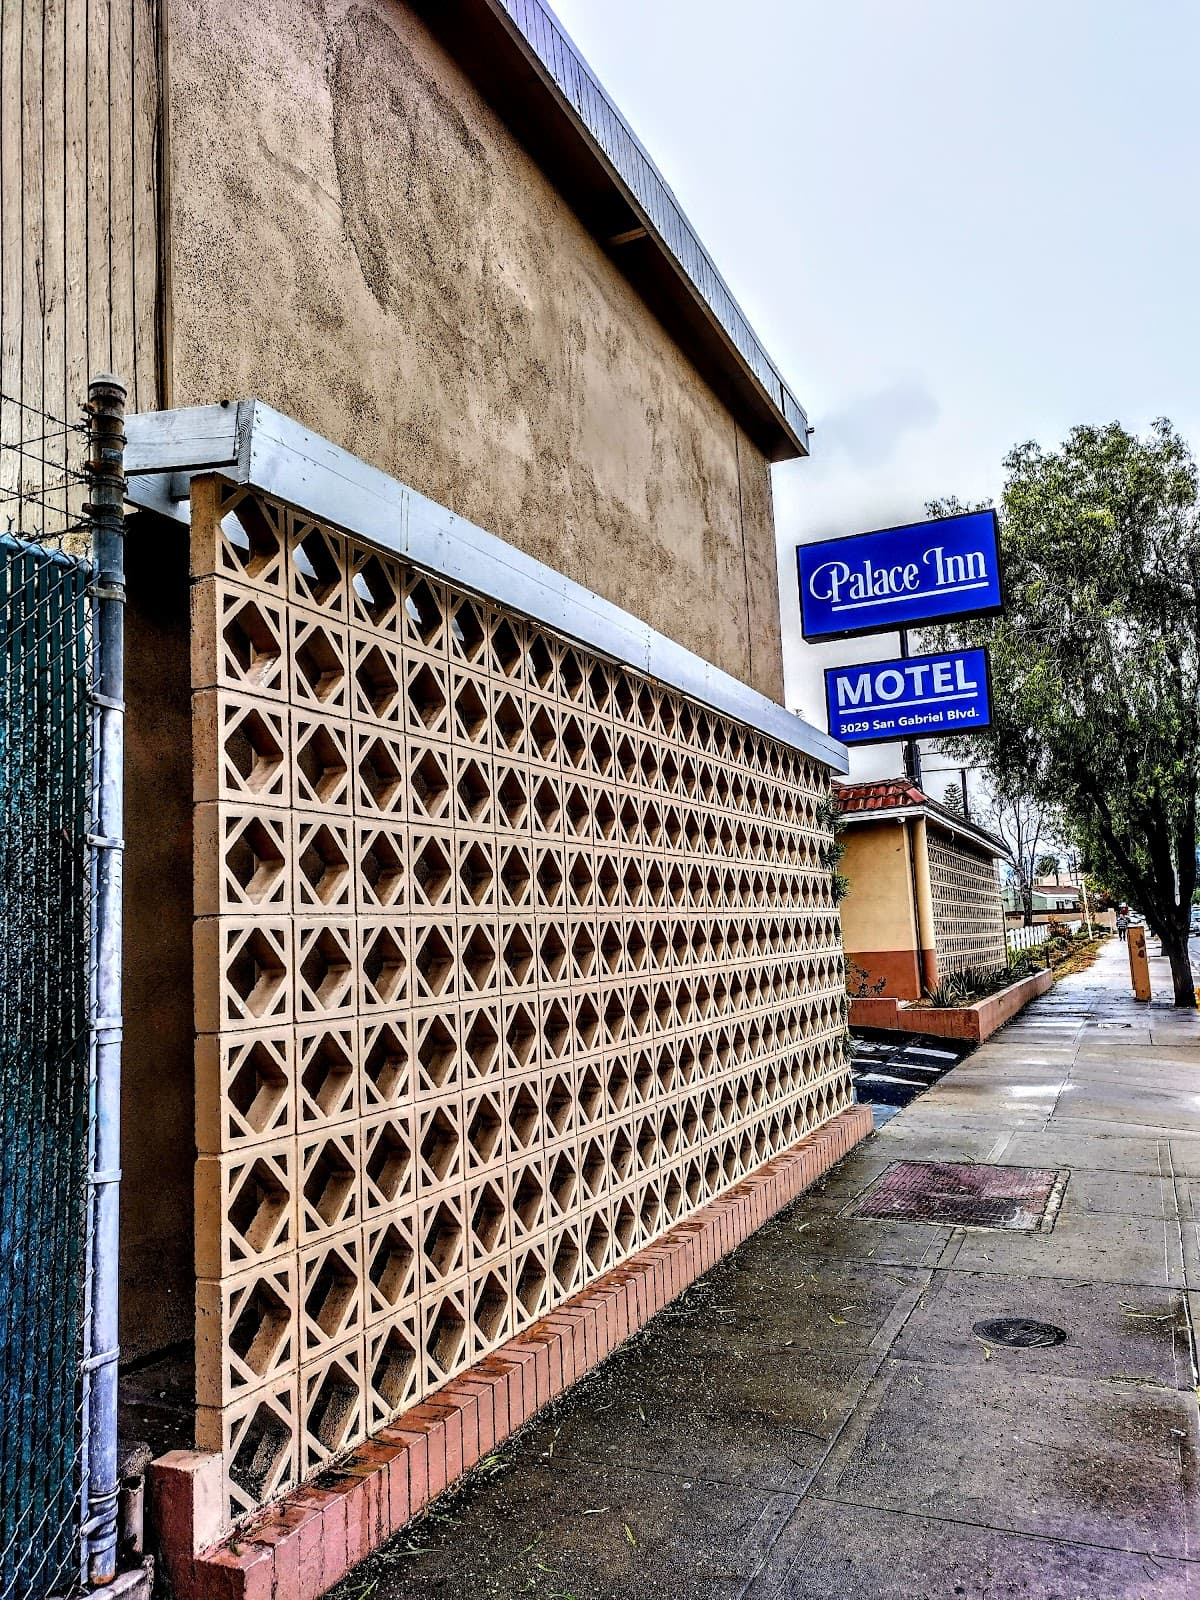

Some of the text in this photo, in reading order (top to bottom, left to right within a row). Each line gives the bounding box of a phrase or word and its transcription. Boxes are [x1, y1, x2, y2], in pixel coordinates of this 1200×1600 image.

[809, 547, 988, 603] Palace Inn
[836, 659, 978, 707] MOTEL
[840, 707, 980, 734] 3029 San Gabriel Blvd.
